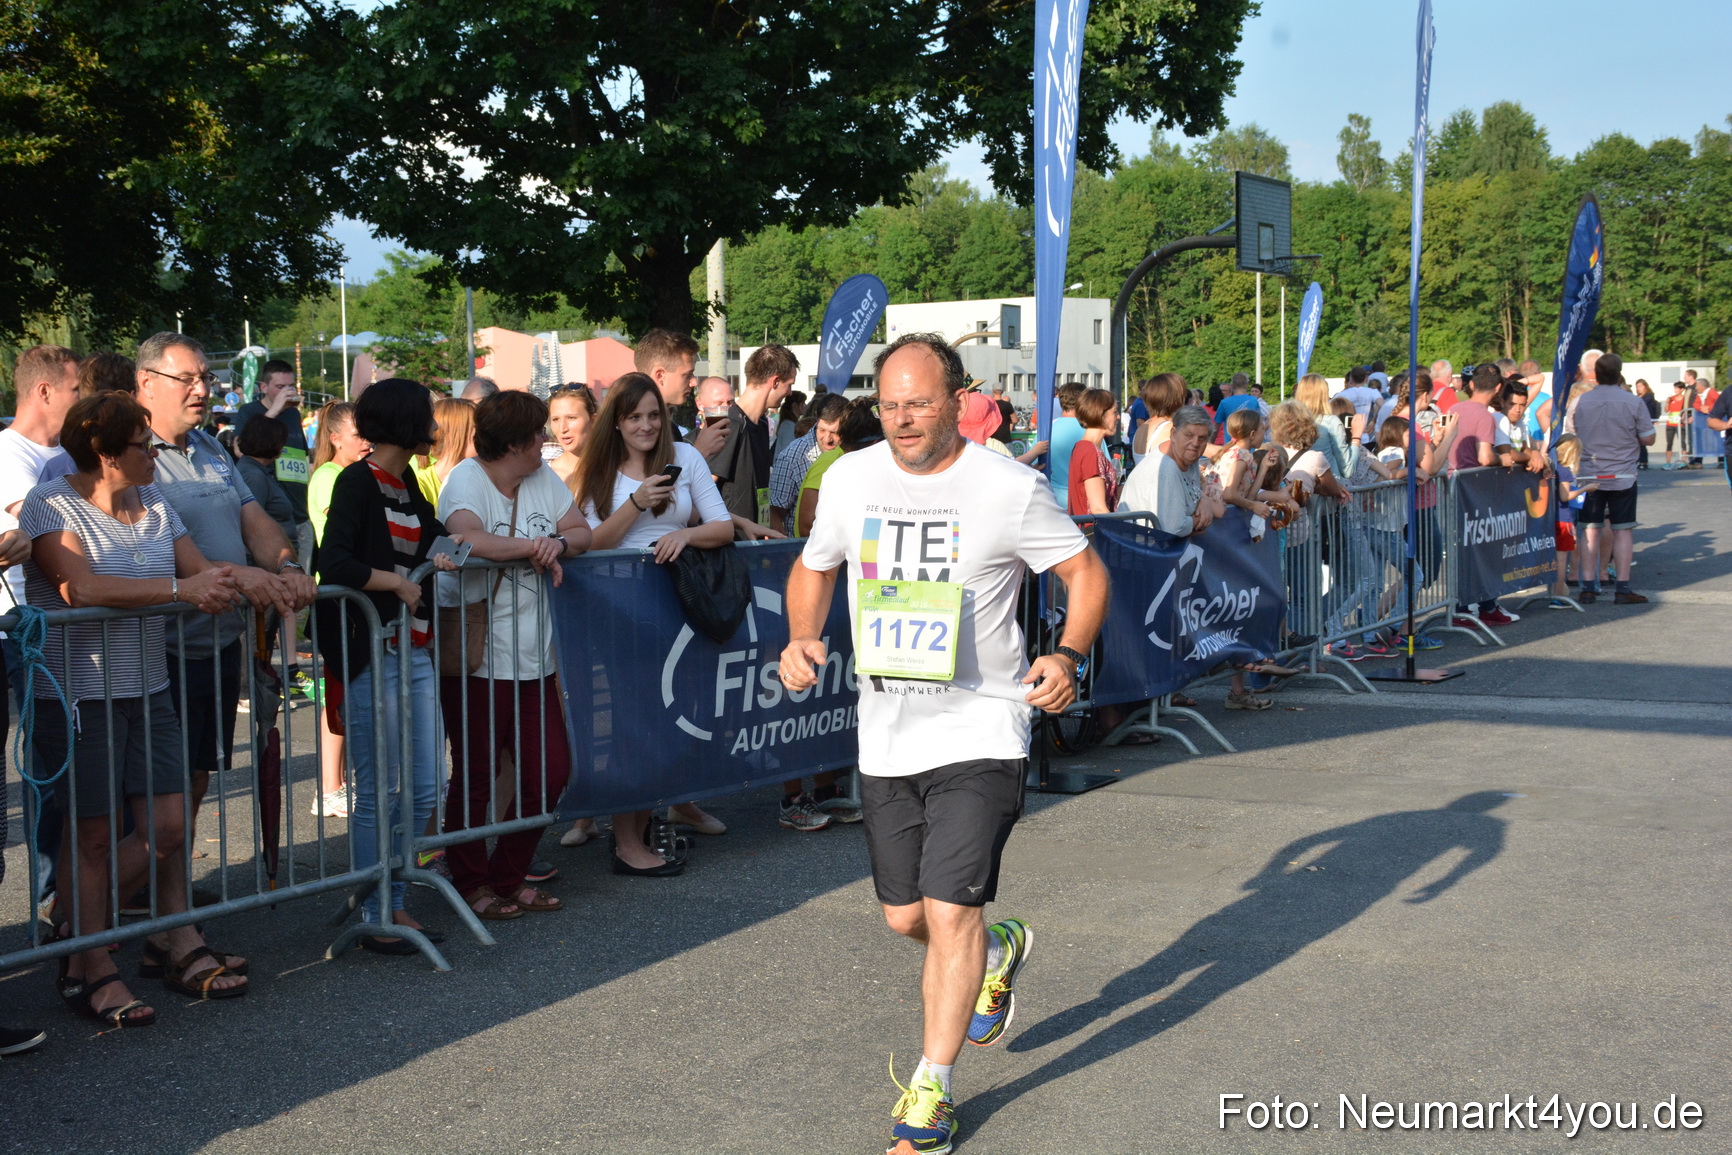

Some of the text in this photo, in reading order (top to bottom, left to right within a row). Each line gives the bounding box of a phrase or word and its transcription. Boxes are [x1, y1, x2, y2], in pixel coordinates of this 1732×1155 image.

[835, 288, 874, 358] Fischer
[847, 301, 878, 357] AUTOMOBILE
[279, 460, 306, 474] 1493
[882, 506, 904, 515] NEUE
[887, 519, 948, 564] TE
[1178, 581, 1260, 637] Fischer
[869, 617, 948, 652] 1172
[886, 655, 905, 663] Stefan
[887, 684, 951, 696] RAUMWERK
